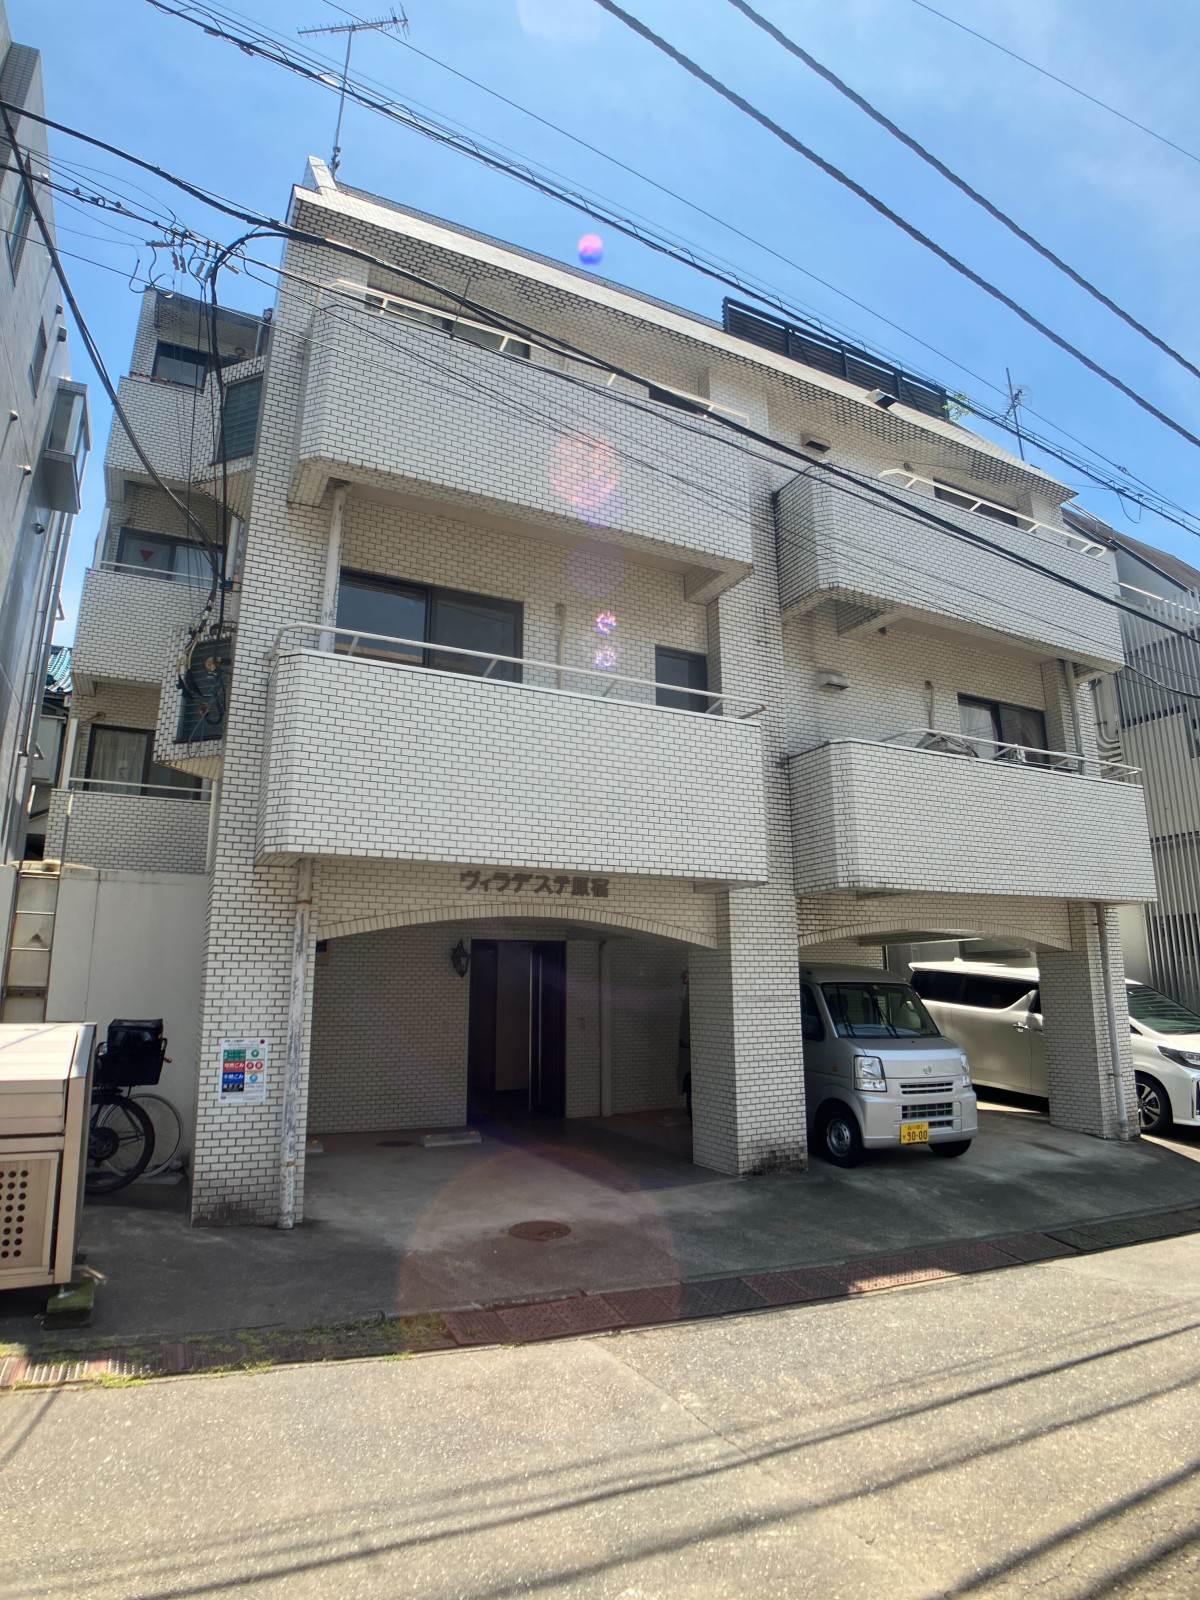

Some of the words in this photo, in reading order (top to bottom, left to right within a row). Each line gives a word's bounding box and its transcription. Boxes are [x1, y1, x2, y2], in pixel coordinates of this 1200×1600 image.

[460, 870, 609, 898] ヴィラデステ原宿
[906, 1130, 927, 1141] 90-00
